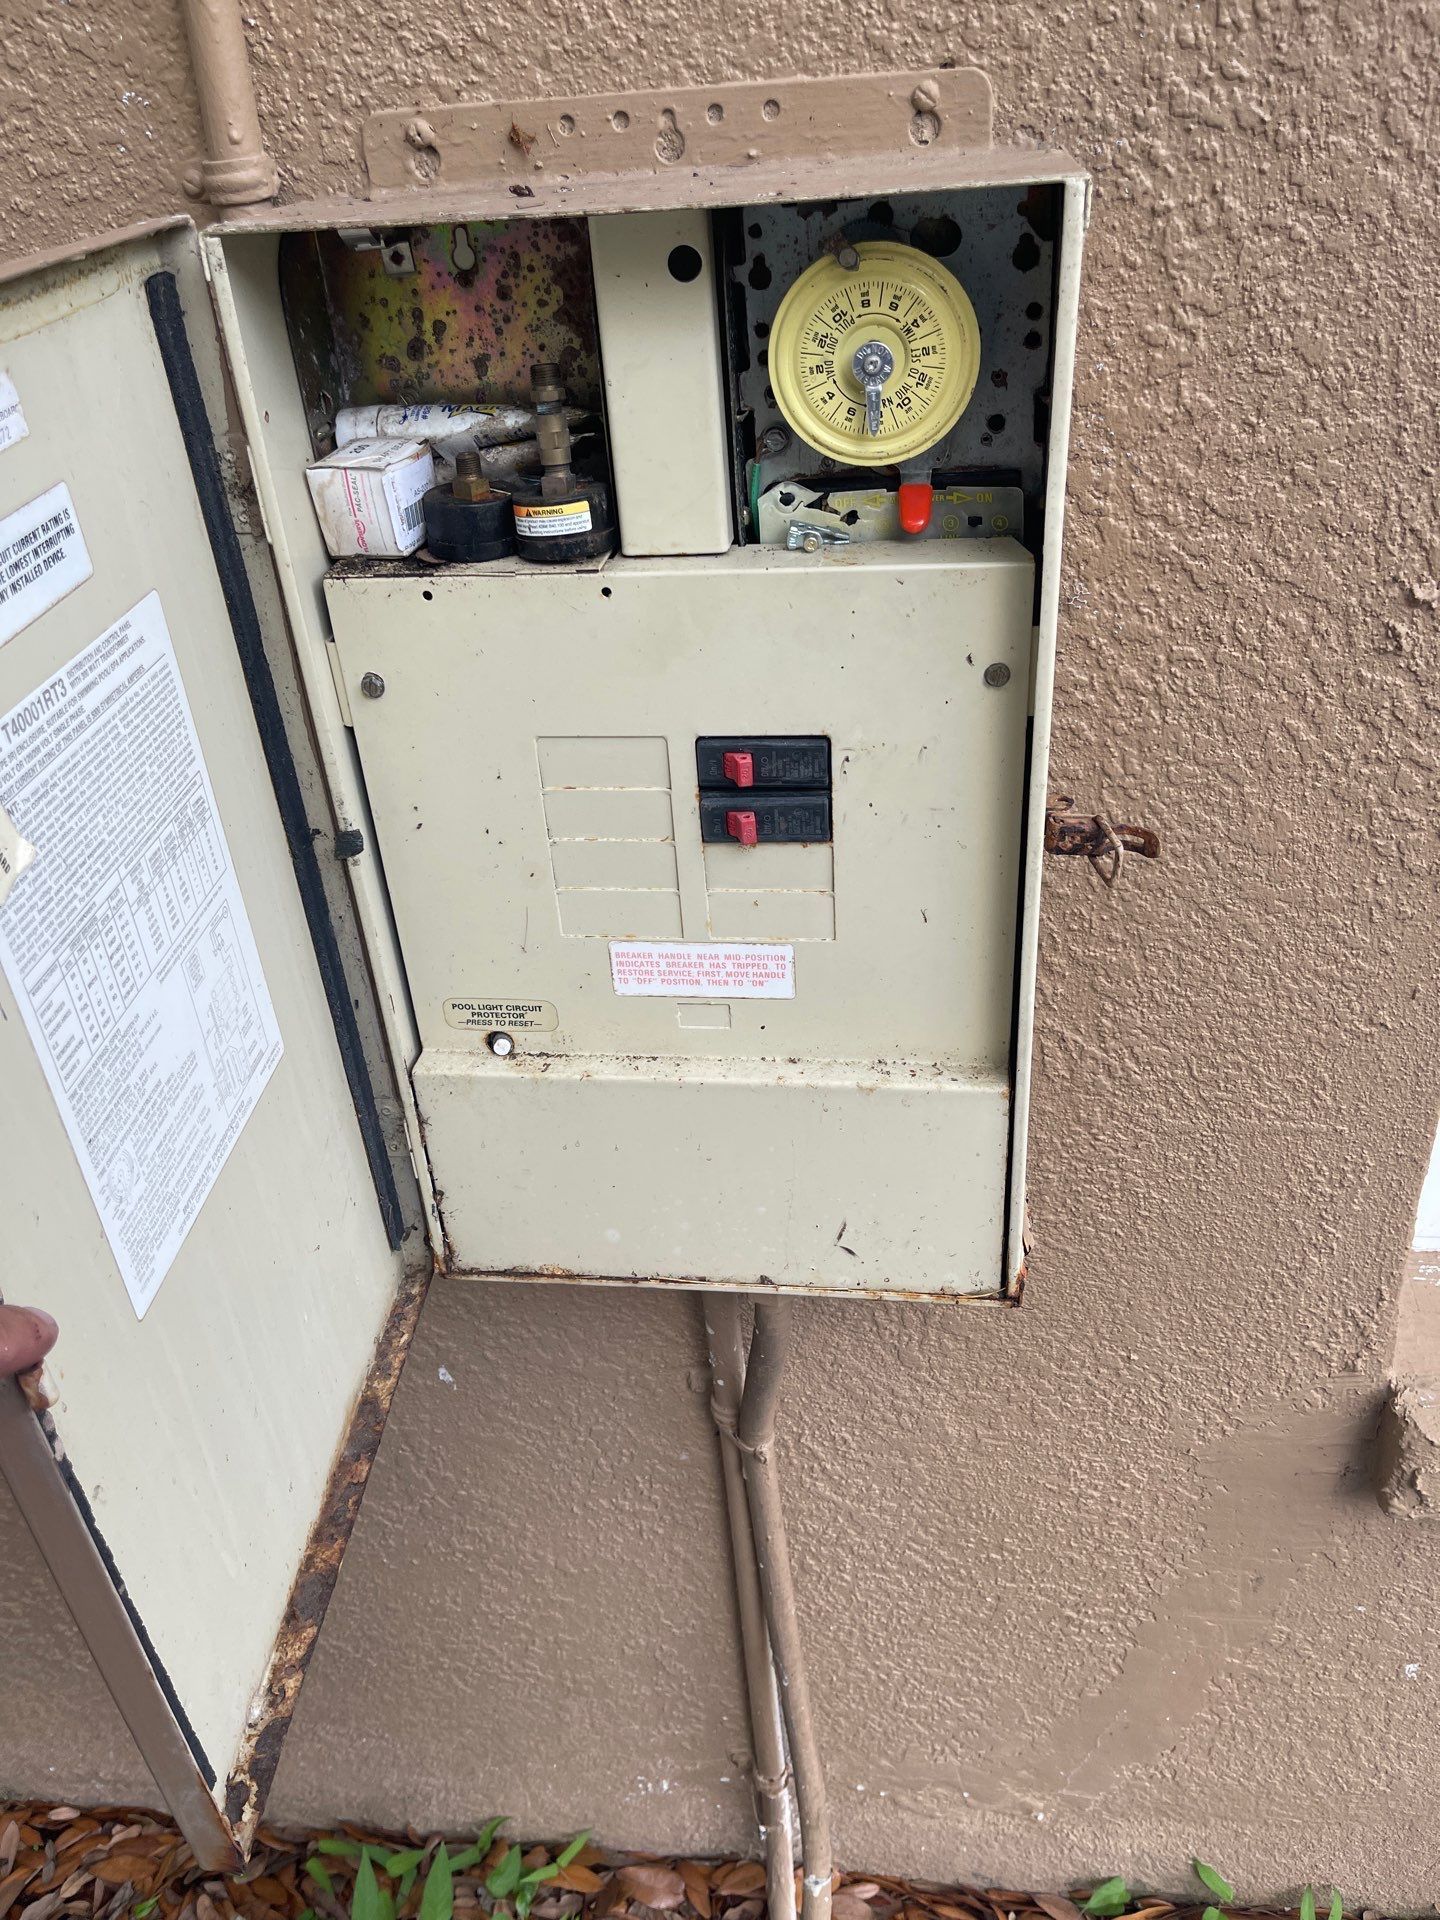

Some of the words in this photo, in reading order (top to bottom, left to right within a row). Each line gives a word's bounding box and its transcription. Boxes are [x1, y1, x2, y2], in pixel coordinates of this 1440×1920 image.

[861, 299, 871, 308] 8
[832, 309, 848, 324] 10
[911, 318, 921, 329] 4
[834, 314, 856, 335] PULL
[899, 321, 918, 344] TIME
[816, 332, 829, 349] 12
[910, 347, 922, 363] SET
[921, 346, 930, 357] 2
[815, 364, 824, 375] 2
[823, 360, 836, 381] DIAL
[907, 367, 920, 380] TO
[915, 372, 928, 388] 12
[826, 391, 835, 400] 4
[895, 382, 913, 400] DIAL
[896, 396, 912, 410] 10
[847, 406, 857, 417] 6
[976, 492, 993, 503] ON
[12, 527, 42, 556] CURRENT
[41, 512, 64, 537] RATING
[62, 508, 71, 521] IS
[5, 551, 33, 580] LOWEST
[31, 522, 75, 560] INTERRUPTING
[9, 563, 43, 597] INSTALLED
[0, 676, 68, 746] T40001RT3
[658, 952, 692, 960] HANDLE
[616, 960, 660, 968] INDICATES
